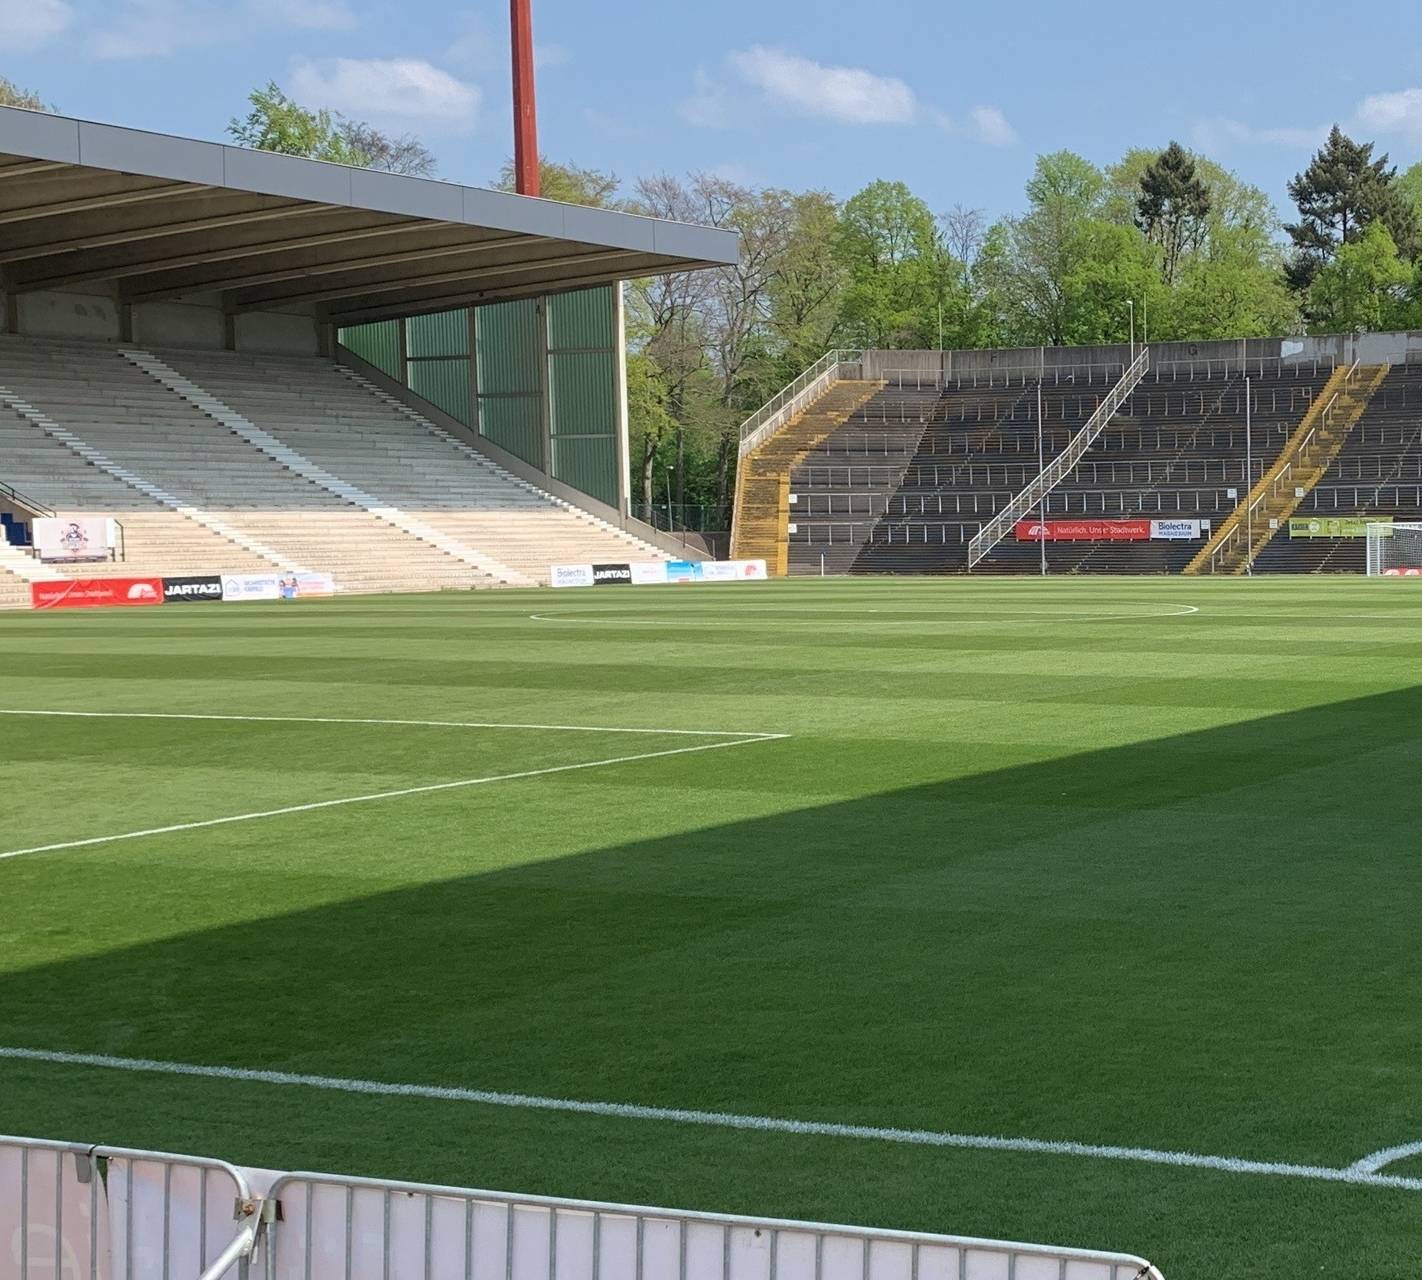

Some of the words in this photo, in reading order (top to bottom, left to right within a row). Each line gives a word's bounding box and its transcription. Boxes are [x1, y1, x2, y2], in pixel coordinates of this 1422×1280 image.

[1057, 526, 1088, 534] Natürlich.
[1110, 525, 1145, 534] Stadtwerk.
[1158, 521, 1192, 530] Biolectra
[594, 570, 630, 579] JARTAZI
[165, 584, 221, 595] JARTAZI
